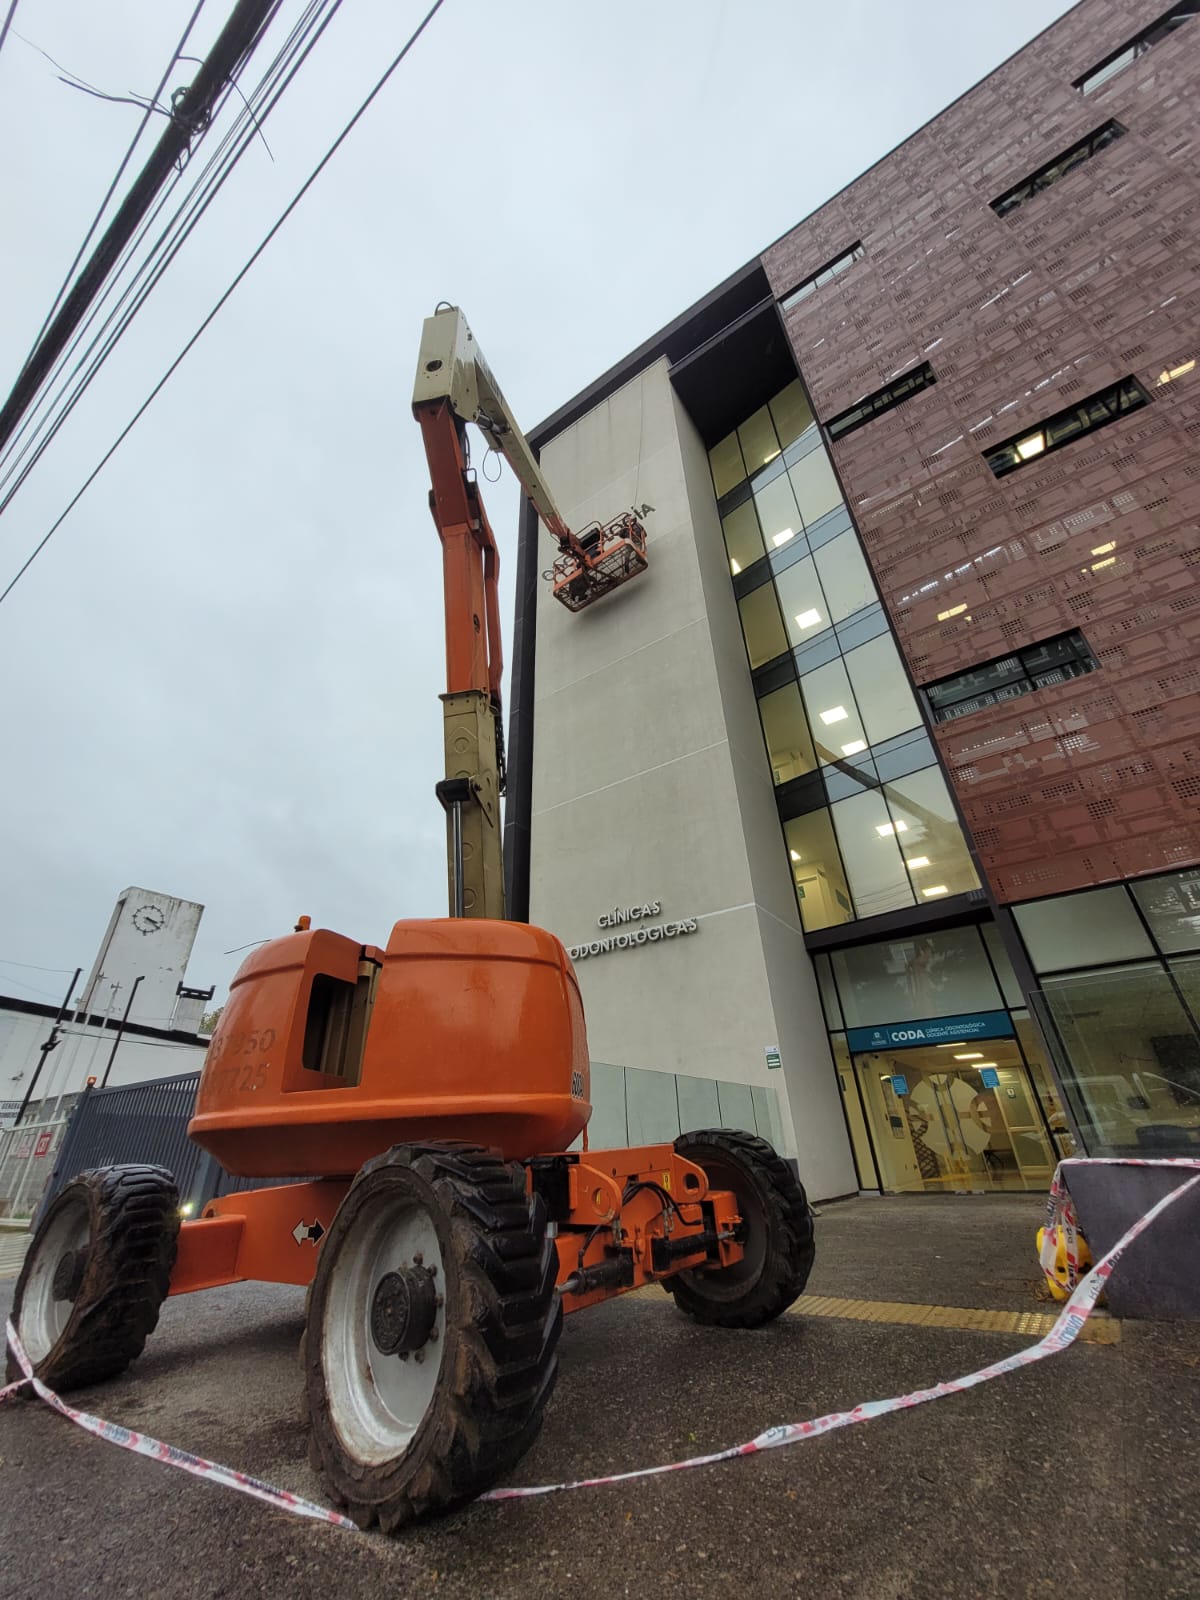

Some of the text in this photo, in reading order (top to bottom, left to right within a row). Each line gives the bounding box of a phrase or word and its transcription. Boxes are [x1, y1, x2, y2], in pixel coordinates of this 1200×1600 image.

[597, 899, 662, 928] CLÍNICAS
[569, 917, 699, 959] ODONTOLÓGICAS
[891, 1029, 925, 1042] CODA
